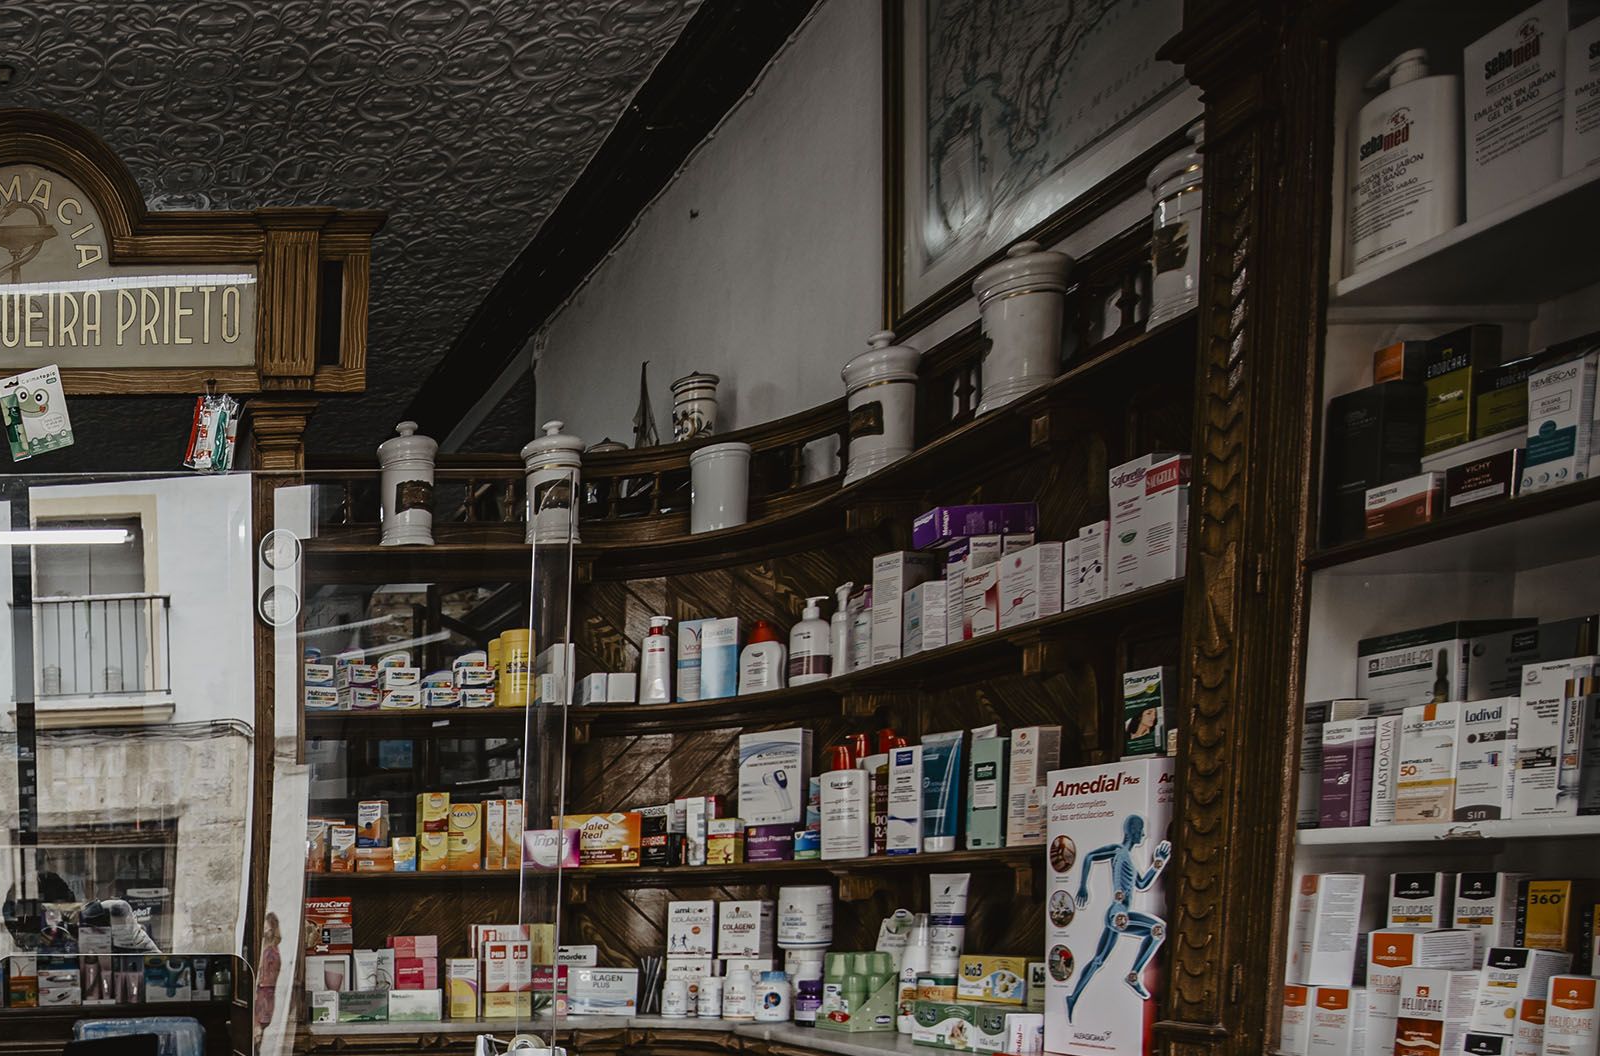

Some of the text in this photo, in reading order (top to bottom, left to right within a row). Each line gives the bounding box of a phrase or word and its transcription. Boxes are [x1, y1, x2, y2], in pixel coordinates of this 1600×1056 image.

[1484, 34, 1541, 81] sebamed
[115, 285, 243, 346] PRIETO
[1464, 706, 1503, 723] Ladival
[1568, 700, 1577, 727] Screen
[1377, 720, 1393, 800] BLASTOACTIVA
[1052, 772, 1140, 798] Amedial Plus
[1051, 799, 1107, 812] Cuidado completo
[1051, 809, 1115, 822] de las articulaciones
[1466, 808, 1487, 820] sin
[583, 822, 609, 831] Jalea
[581, 831, 603, 839] Real
[768, 834, 791, 842] Pharma
[304, 900, 351, 908] ermaCare
[1391, 904, 1434, 915] HELIOCARE
[722, 922, 756, 931] COLÁGENO
[964, 963, 983, 977] bio3
[1369, 974, 1402, 985] HELIOCA
[1401, 997, 1443, 1013] HELIOCARE
